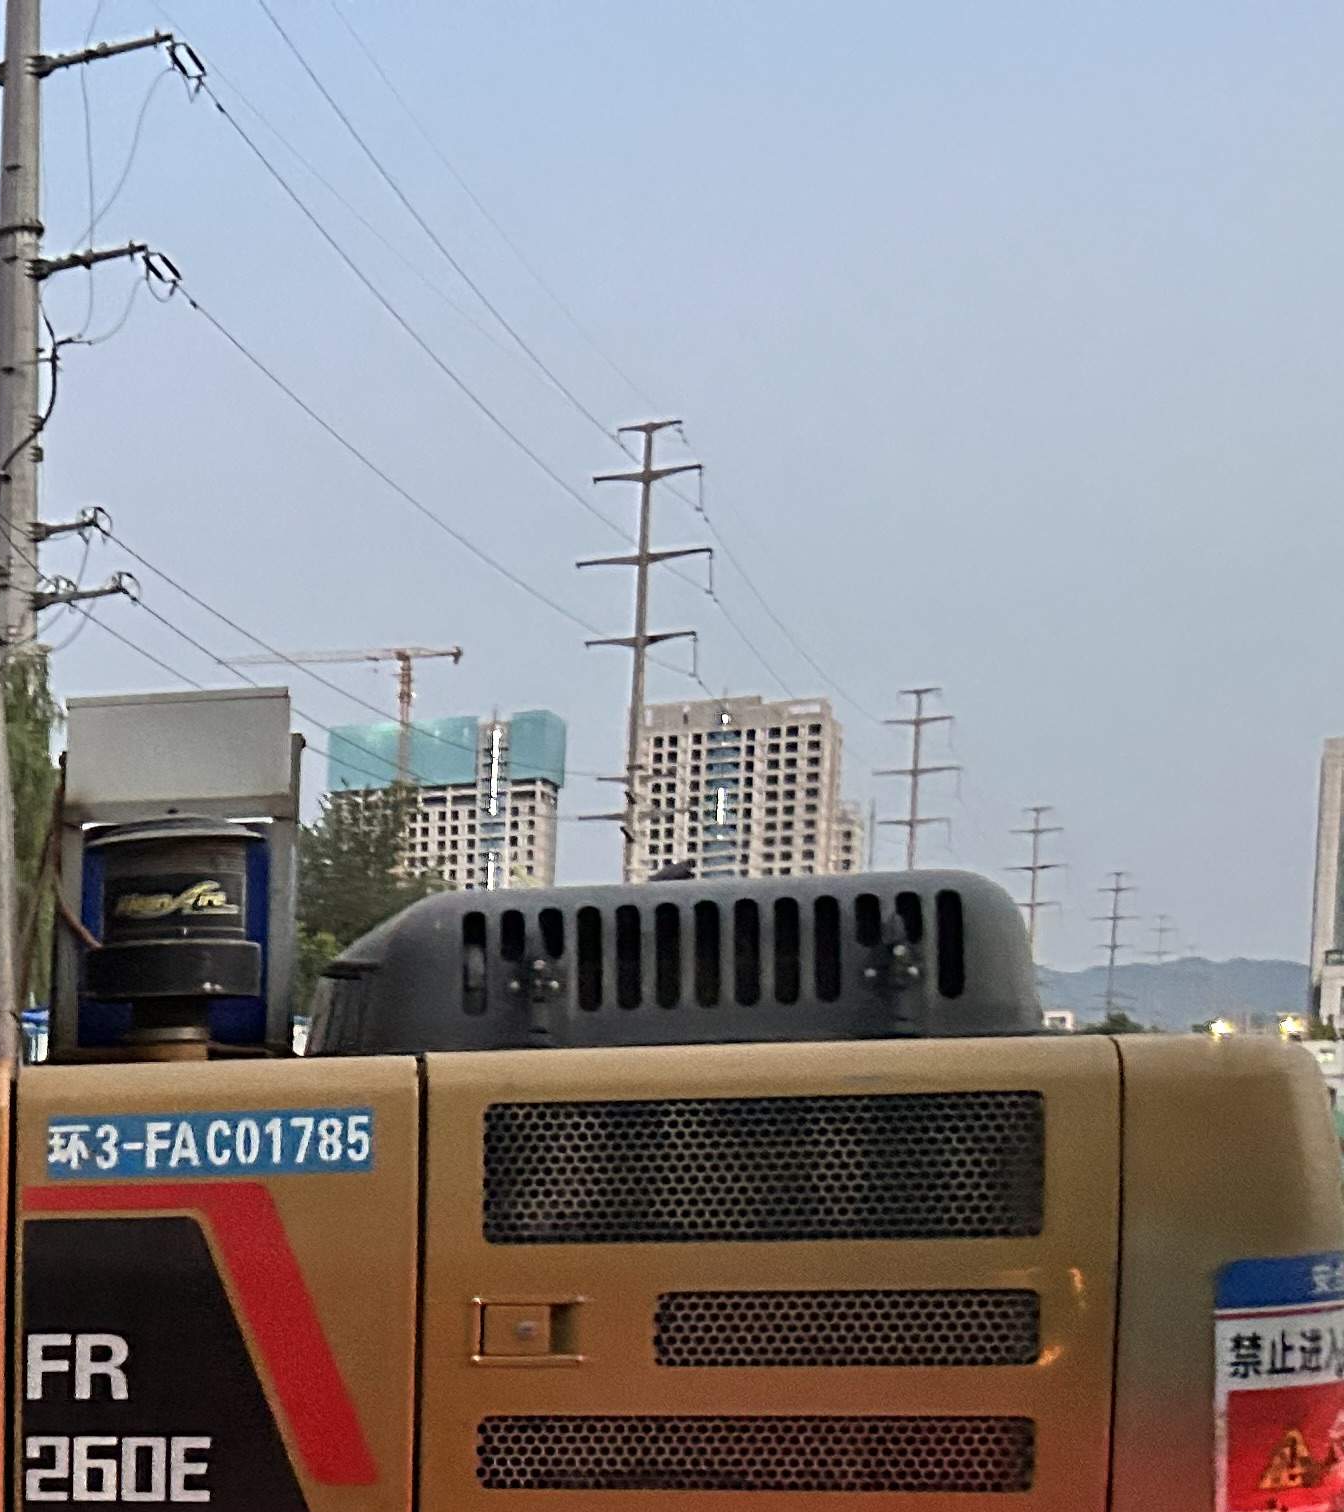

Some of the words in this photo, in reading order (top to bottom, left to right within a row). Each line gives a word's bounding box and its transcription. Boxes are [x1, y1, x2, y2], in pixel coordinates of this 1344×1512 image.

[47, 1115, 370, 1170] 环3-FAC01785
[25, 1333, 130, 1400] FR
[25, 1436, 211, 1502] 260E
